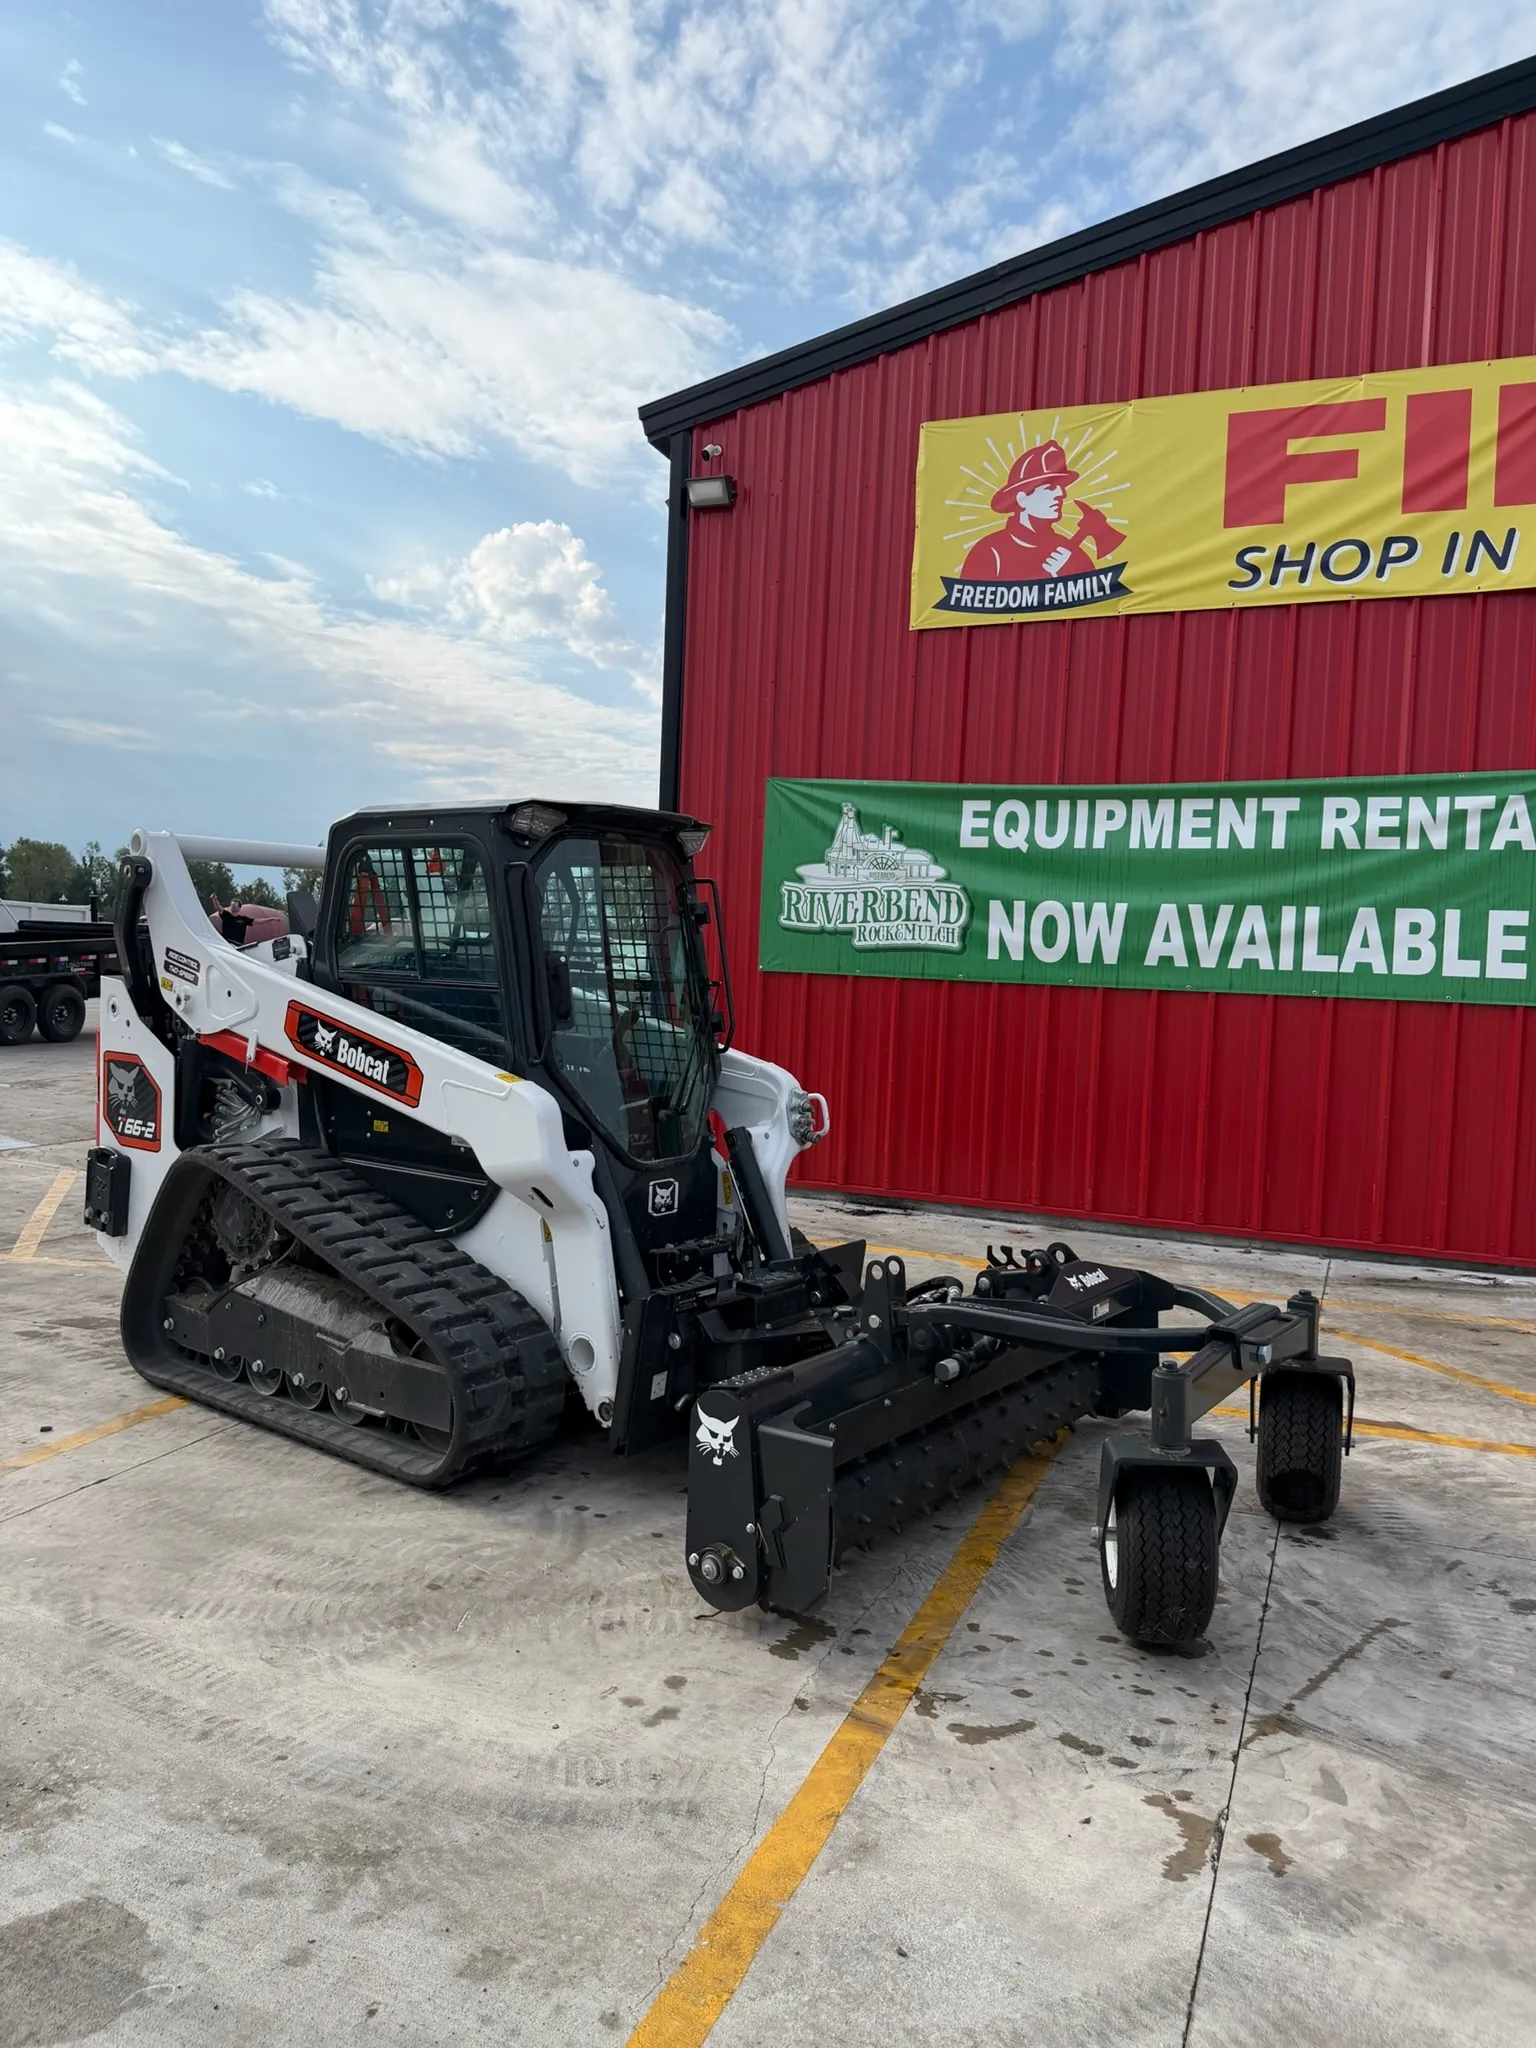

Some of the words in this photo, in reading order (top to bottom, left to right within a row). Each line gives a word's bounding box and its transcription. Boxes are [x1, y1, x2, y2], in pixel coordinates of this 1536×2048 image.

[1223, 382, 1536, 529] FI
[1228, 535, 1422, 591] SHOP
[1441, 527, 1520, 577] IN
[950, 584, 1039, 609] FREEDOM
[1044, 572, 1113, 607] FAMILY
[959, 797, 1301, 853] EQUIPMENT
[1320, 794, 1536, 851] RENTA
[782, 887, 966, 925] RIVERBEND
[987, 900, 1129, 964] NOW
[1143, 903, 1530, 980] AVAILABLE
[337, 1037, 390, 1085] Bobcat
[1078, 1268, 1109, 1288] Bobcat
